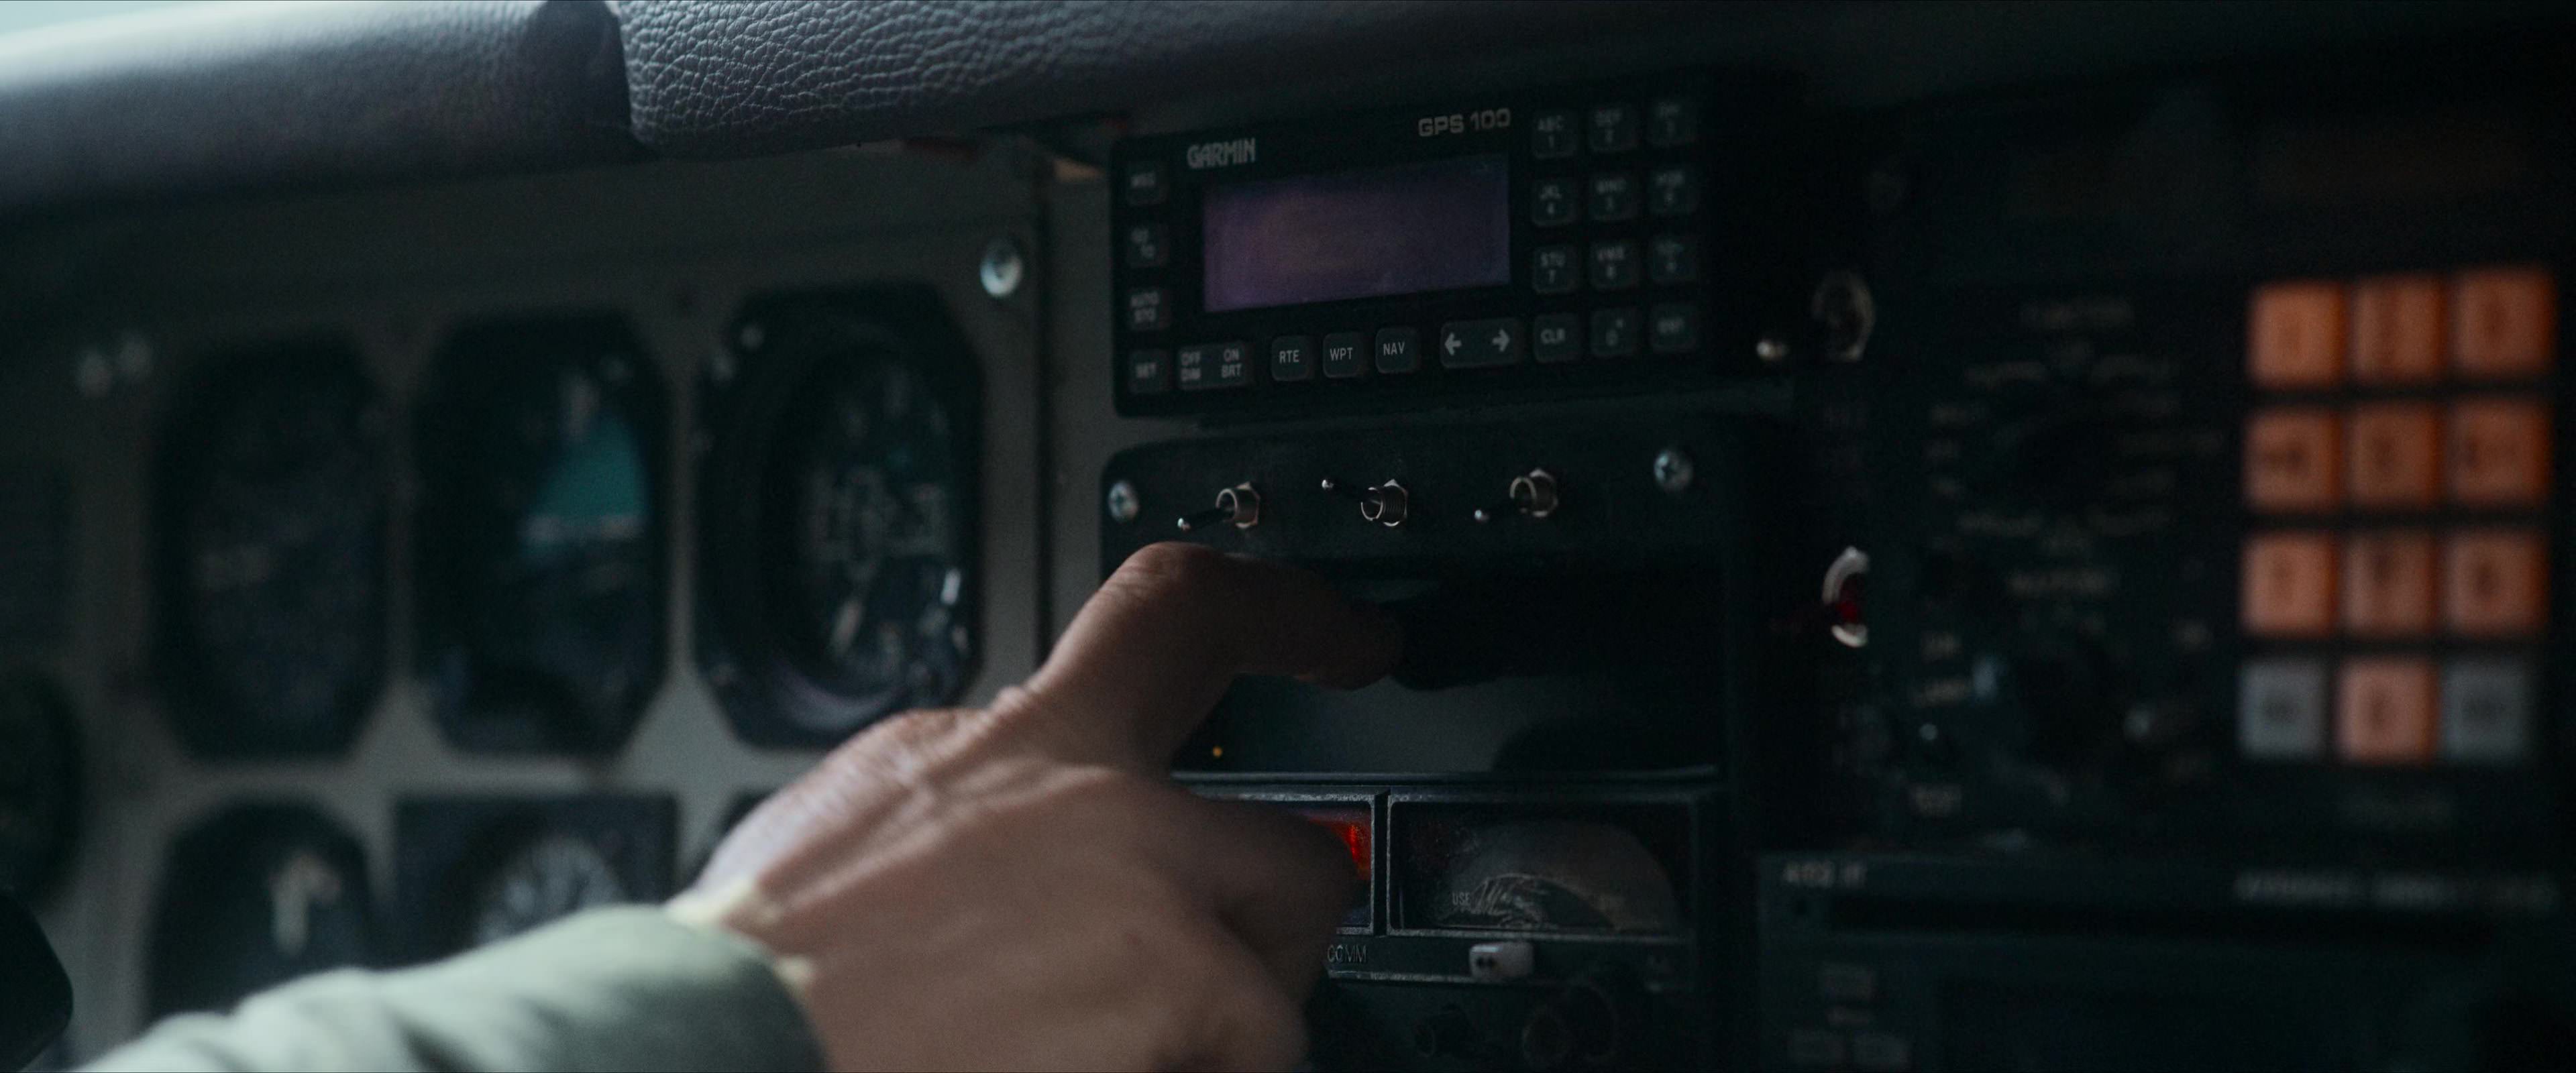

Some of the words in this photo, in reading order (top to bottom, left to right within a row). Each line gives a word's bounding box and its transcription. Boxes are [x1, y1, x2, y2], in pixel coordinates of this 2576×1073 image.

[1417, 114, 1464, 137] GPS
[1470, 107, 1511, 131] 100
[1186, 137, 1257, 170] GARMIN
[1223, 347, 1240, 363] ON
[1278, 349, 1300, 365] RTE
[1329, 347, 1354, 362] WPT
[1382, 341, 1405, 356] NAV
[1180, 349, 1201, 367] OFF
[1221, 362, 1243, 380] BRT
[1451, 892, 1471, 907] USE
[1326, 944, 1367, 963] COMM
